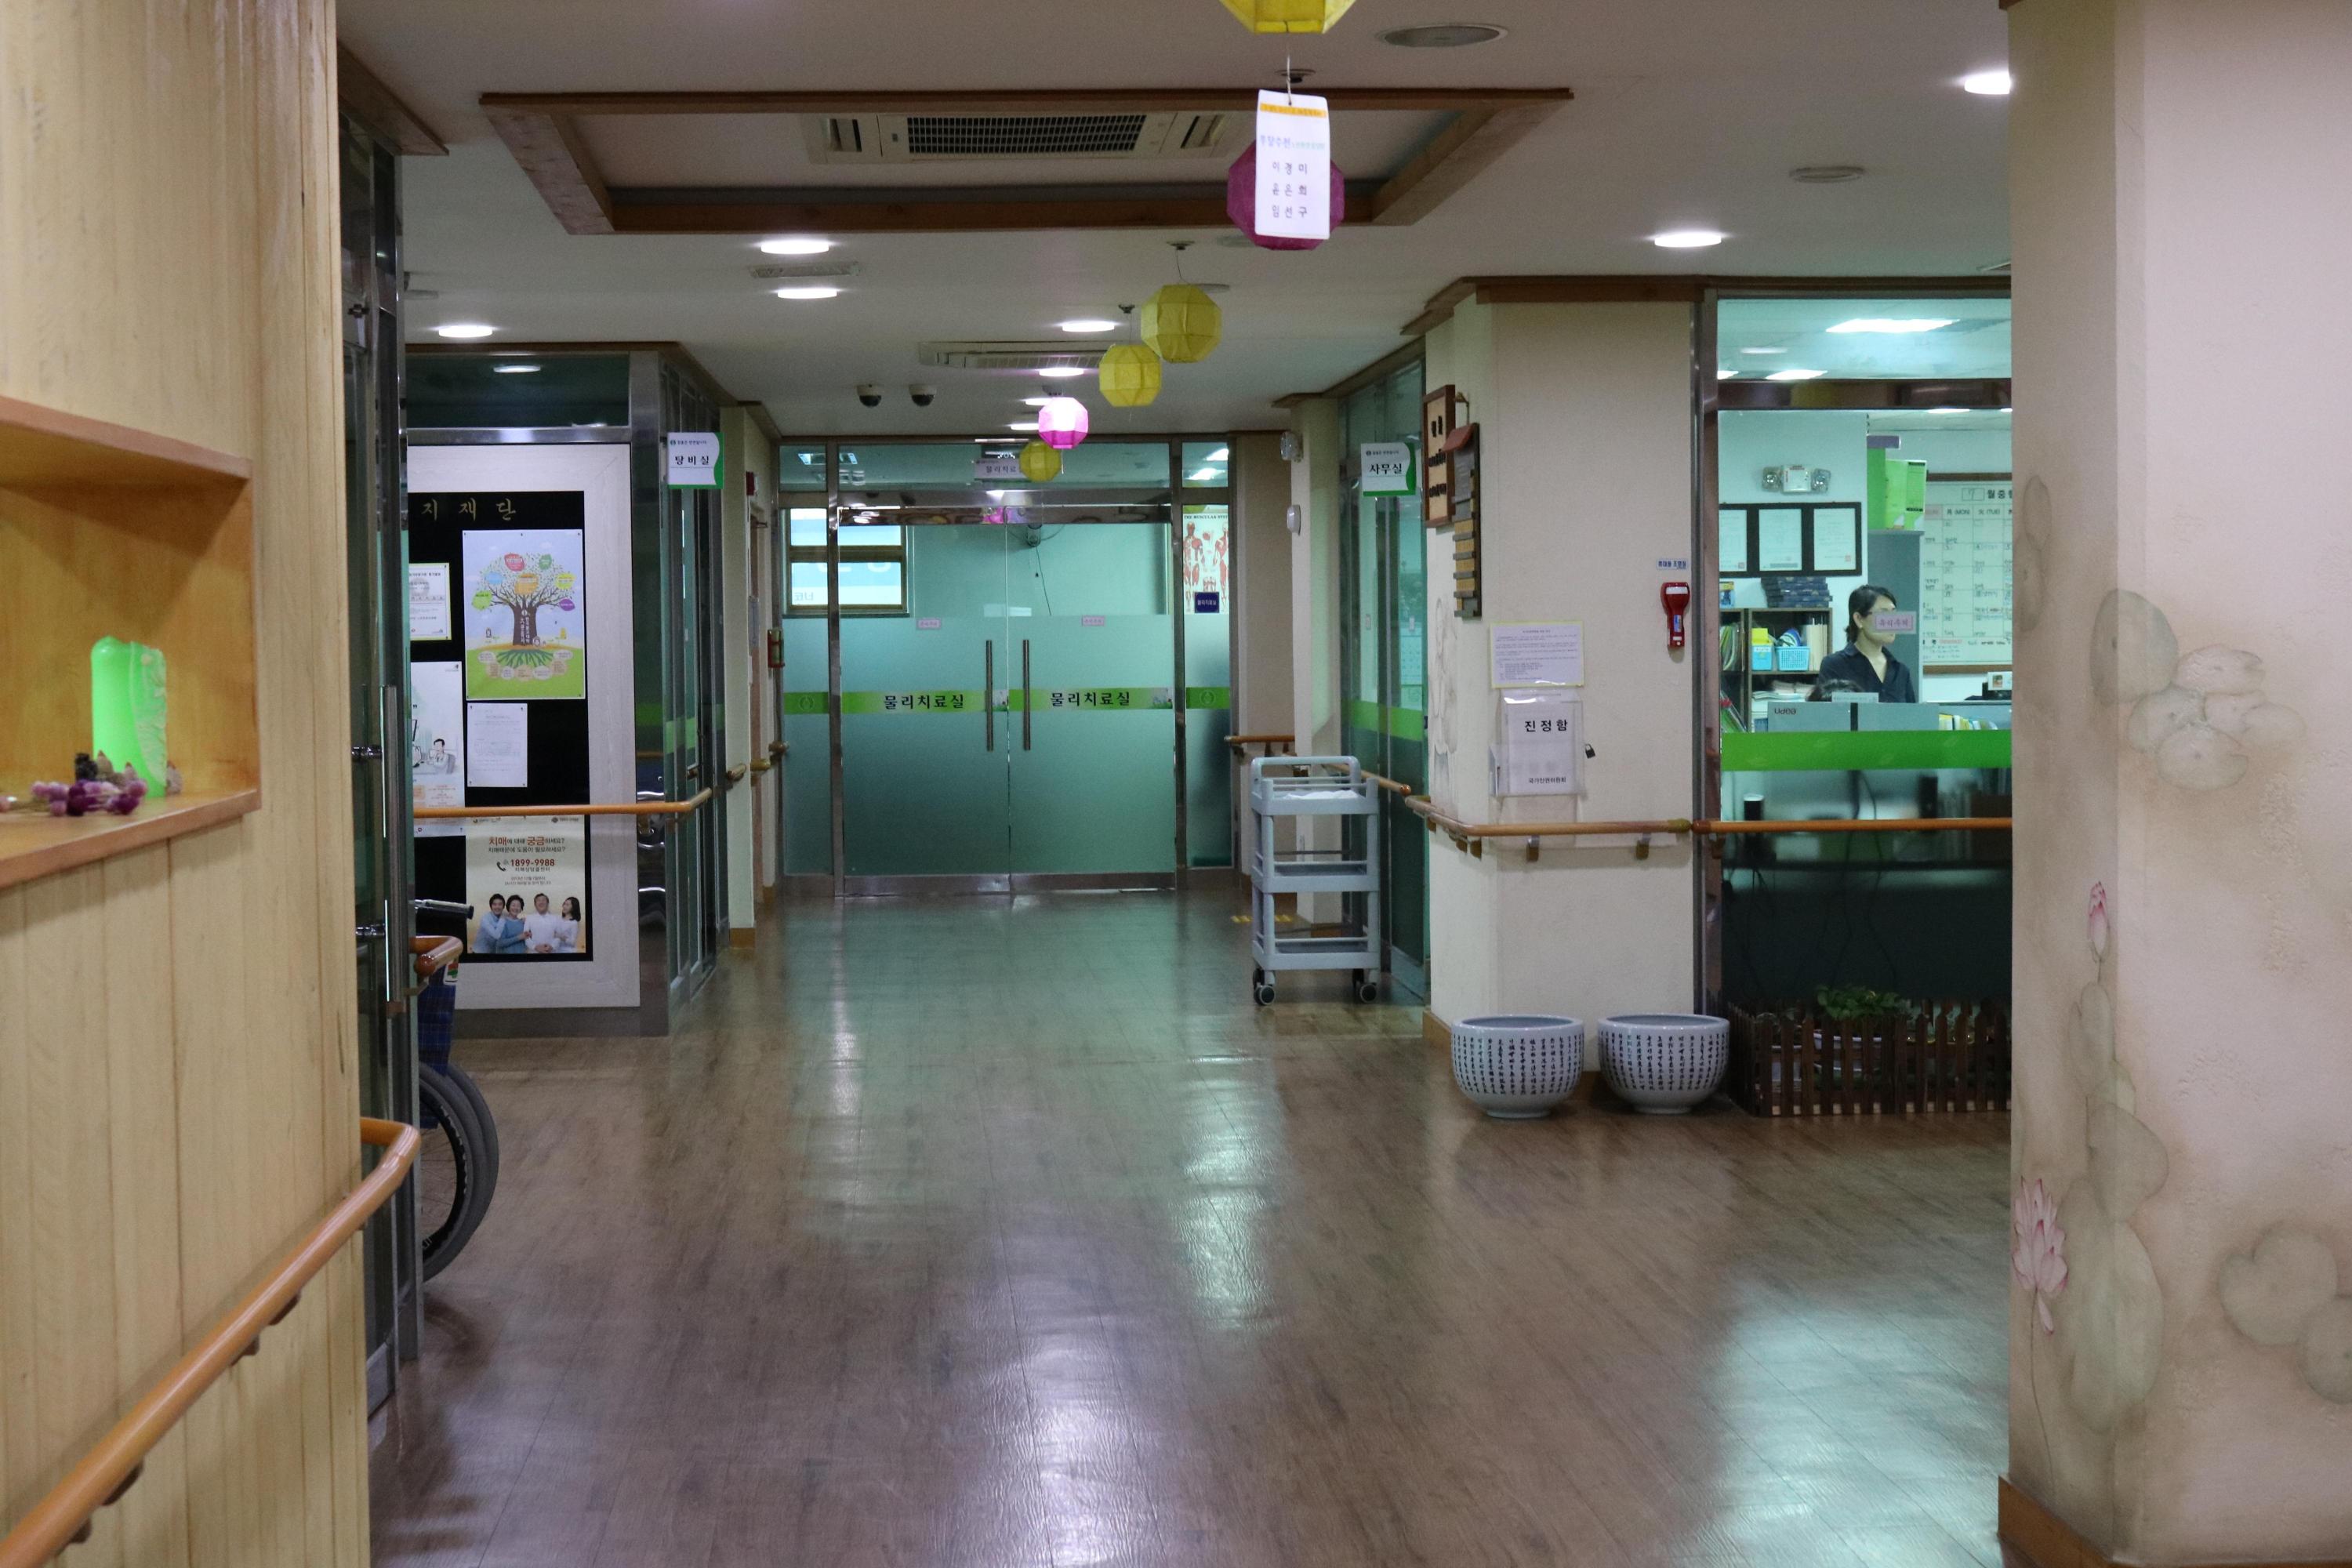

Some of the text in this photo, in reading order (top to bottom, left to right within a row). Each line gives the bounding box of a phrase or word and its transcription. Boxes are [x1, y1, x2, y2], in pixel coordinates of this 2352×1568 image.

[675, 456, 709, 466] 탕비실
[1369, 463, 1402, 474] 사무실
[884, 694, 964, 710] 물리치료실
[1051, 691, 1130, 706] 물리치료실
[1525, 720, 1567, 731] 진정함
[489, 837, 513, 846] 치매에
[527, 837, 564, 846] 궁금하세요?
